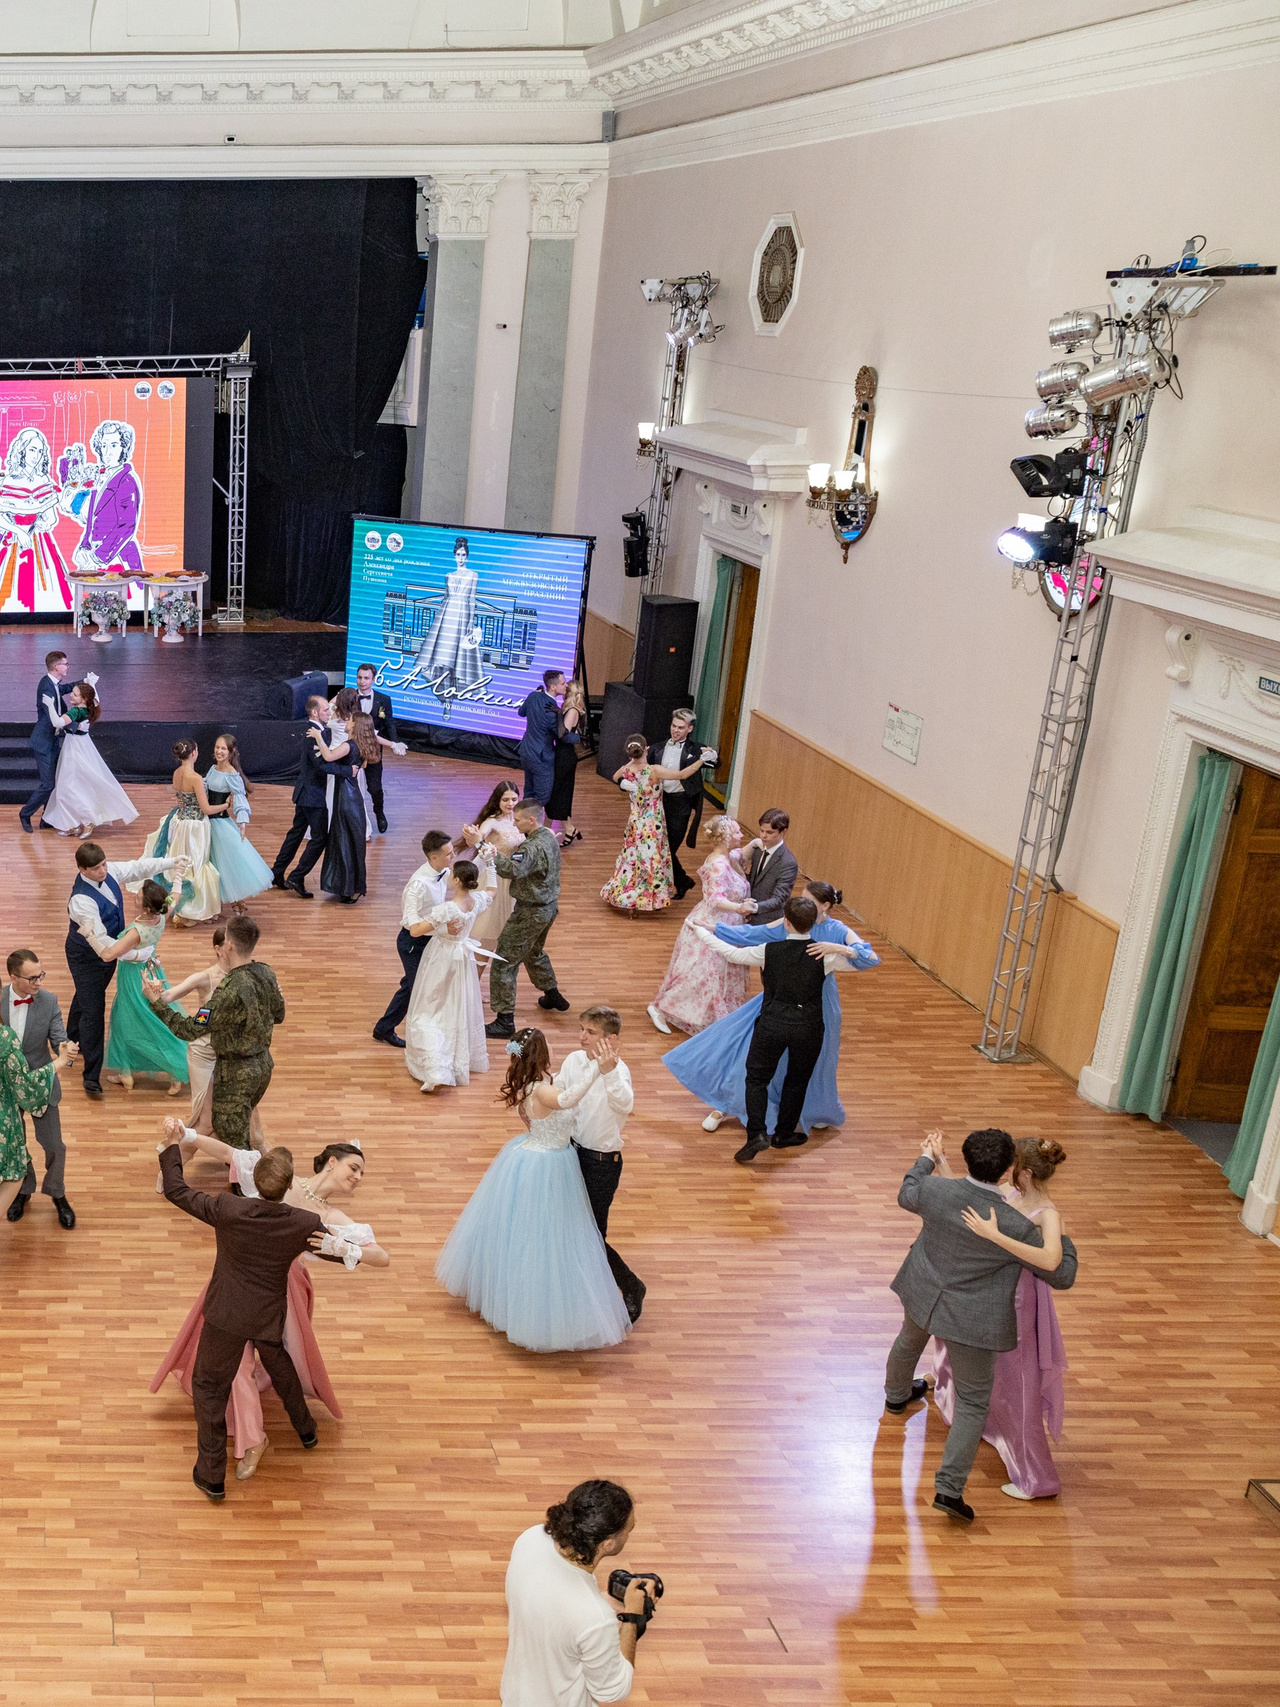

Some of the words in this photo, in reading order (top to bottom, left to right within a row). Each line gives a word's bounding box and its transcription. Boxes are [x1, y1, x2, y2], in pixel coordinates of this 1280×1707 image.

[522, 572, 569, 583] ОТКРЫТЫЙ
[502, 578, 568, 592] МЕЖВУЗОВСКИЙ
[524, 590, 567, 600] ПРАЗДНИК
